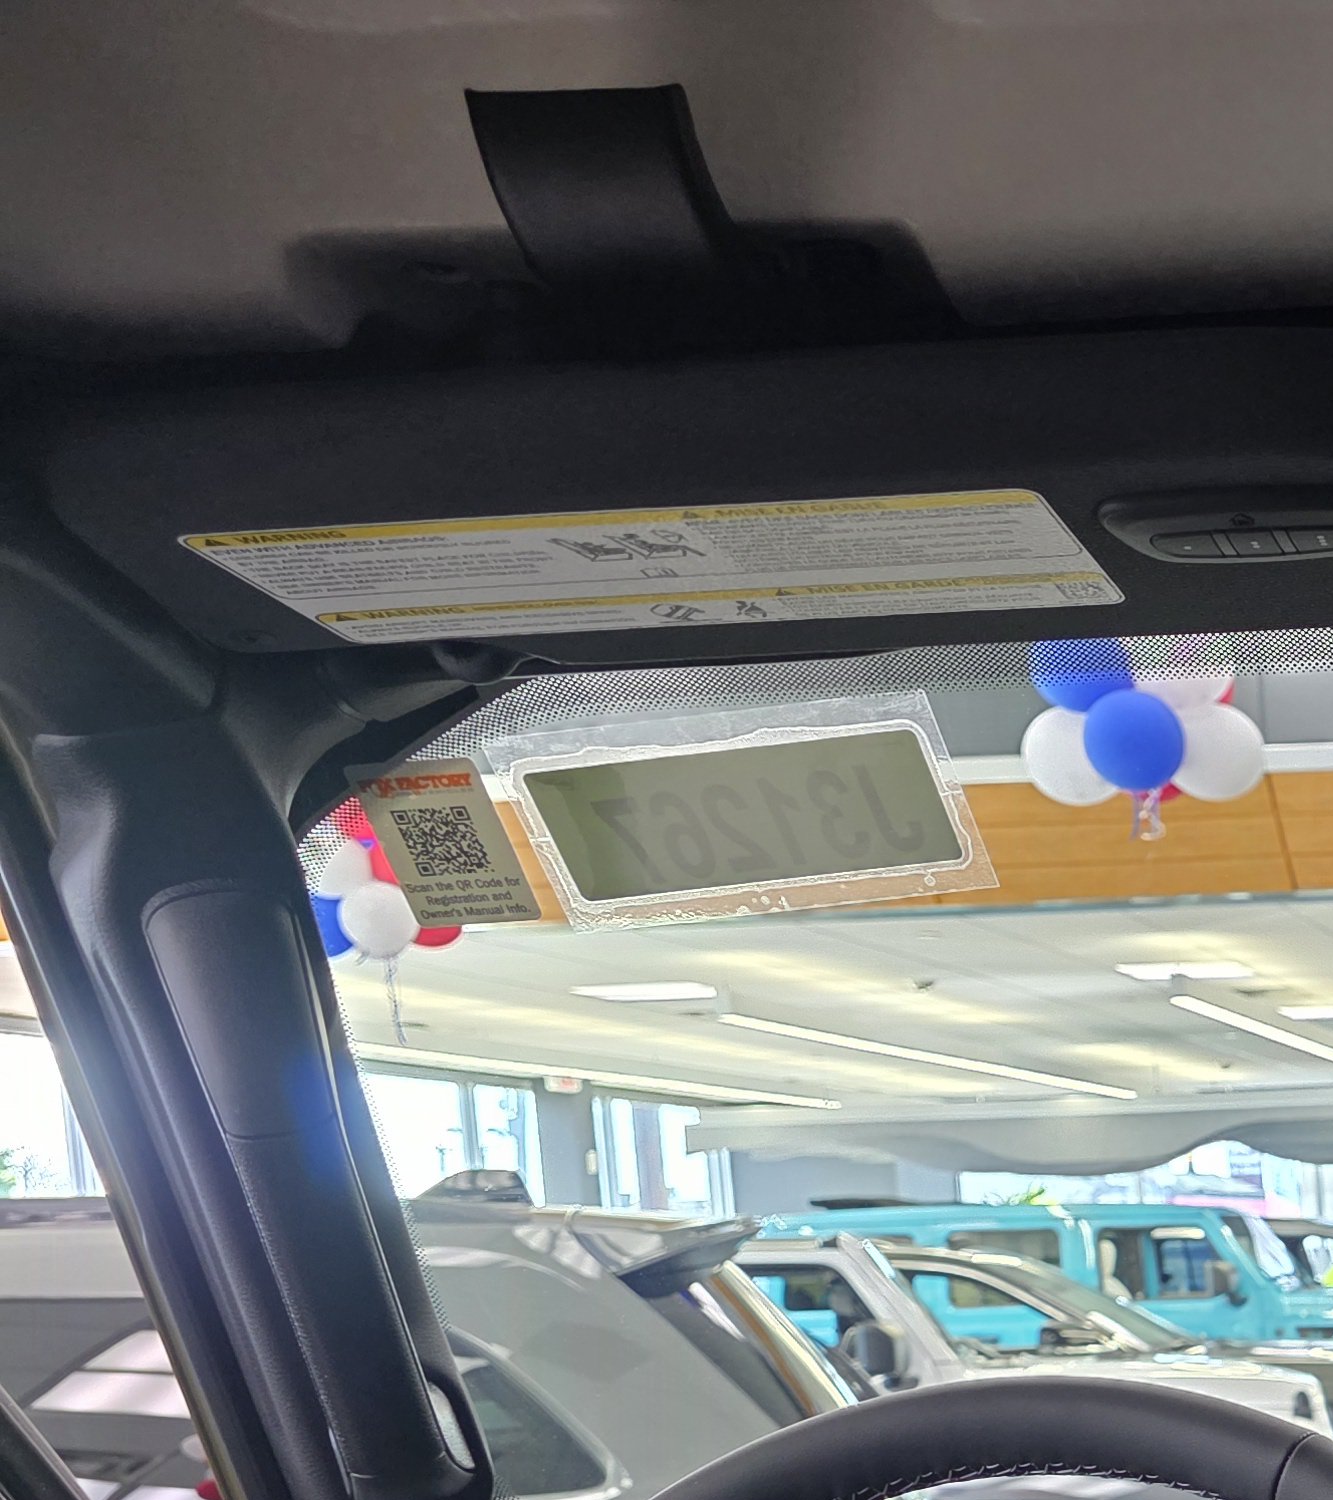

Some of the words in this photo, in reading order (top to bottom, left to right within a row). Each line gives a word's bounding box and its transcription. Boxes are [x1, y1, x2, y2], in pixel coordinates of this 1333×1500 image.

[235, 530, 347, 545] WARNING
[400, 773, 472, 790] FACTORY
[406, 882, 435, 893] Scan
[437, 880, 454, 891] the
[456, 880, 474, 890] QR
[476, 877, 503, 889] Code
[504, 876, 521, 887] for
[425, 893, 491, 908] Registration
[492, 890, 513, 902] and
[421, 908, 463, 920] Owner's
[466, 905, 504, 916] Manual
[507, 903, 532, 914] Info.
